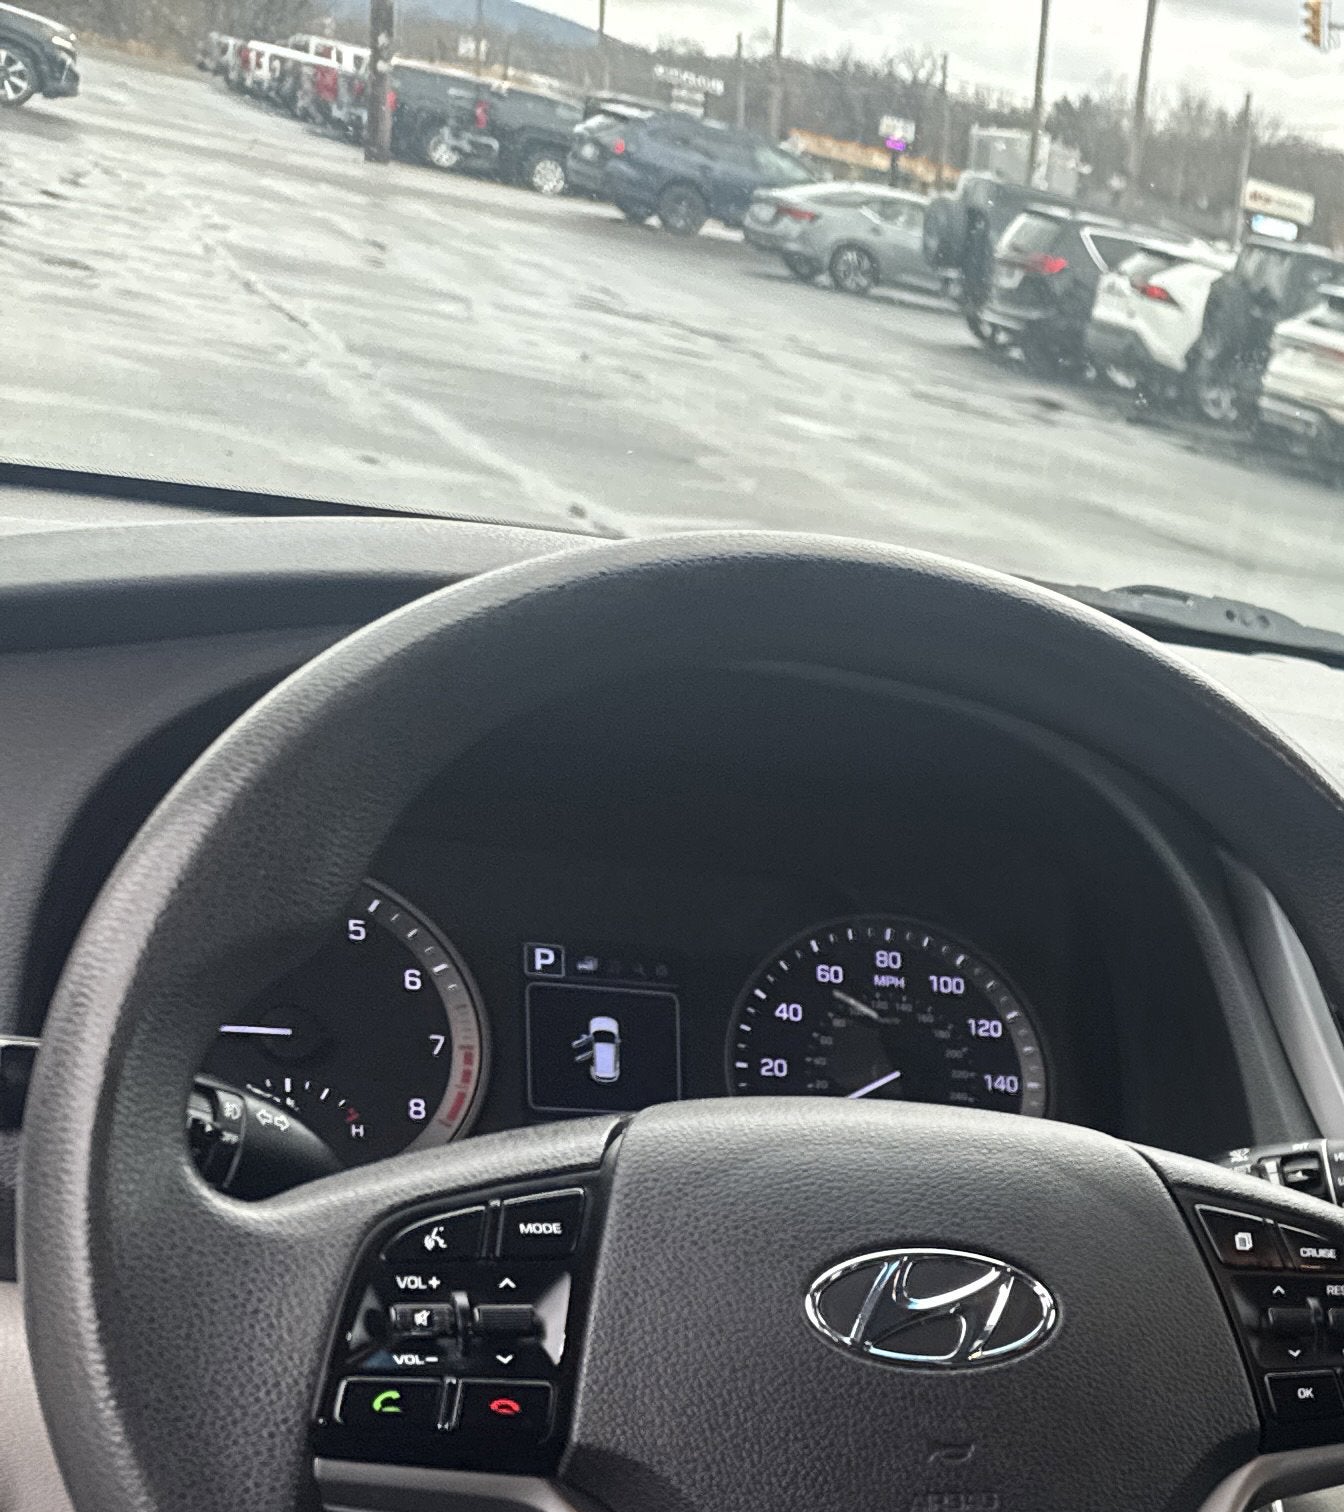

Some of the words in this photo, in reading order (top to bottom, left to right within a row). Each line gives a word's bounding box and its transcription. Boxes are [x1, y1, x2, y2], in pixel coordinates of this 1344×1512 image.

[348, 919, 366, 941] 5
[534, 947, 555, 971] P
[875, 950, 902, 969] 80
[404, 969, 422, 990] 6
[816, 964, 844, 984] 60
[873, 974, 906, 989] MPH
[929, 975, 965, 996] 100
[774, 1002, 803, 1022] 40
[967, 1018, 1003, 1039] 120
[429, 1034, 445, 1056] 7
[760, 1057, 788, 1078] 20
[984, 1074, 1020, 1095] 140
[408, 1098, 426, 1121] 8
[518, 1222, 563, 1236] MODE
[1299, 1246, 1338, 1261] CRUISE
[1297, 1386, 1315, 1400] OK
